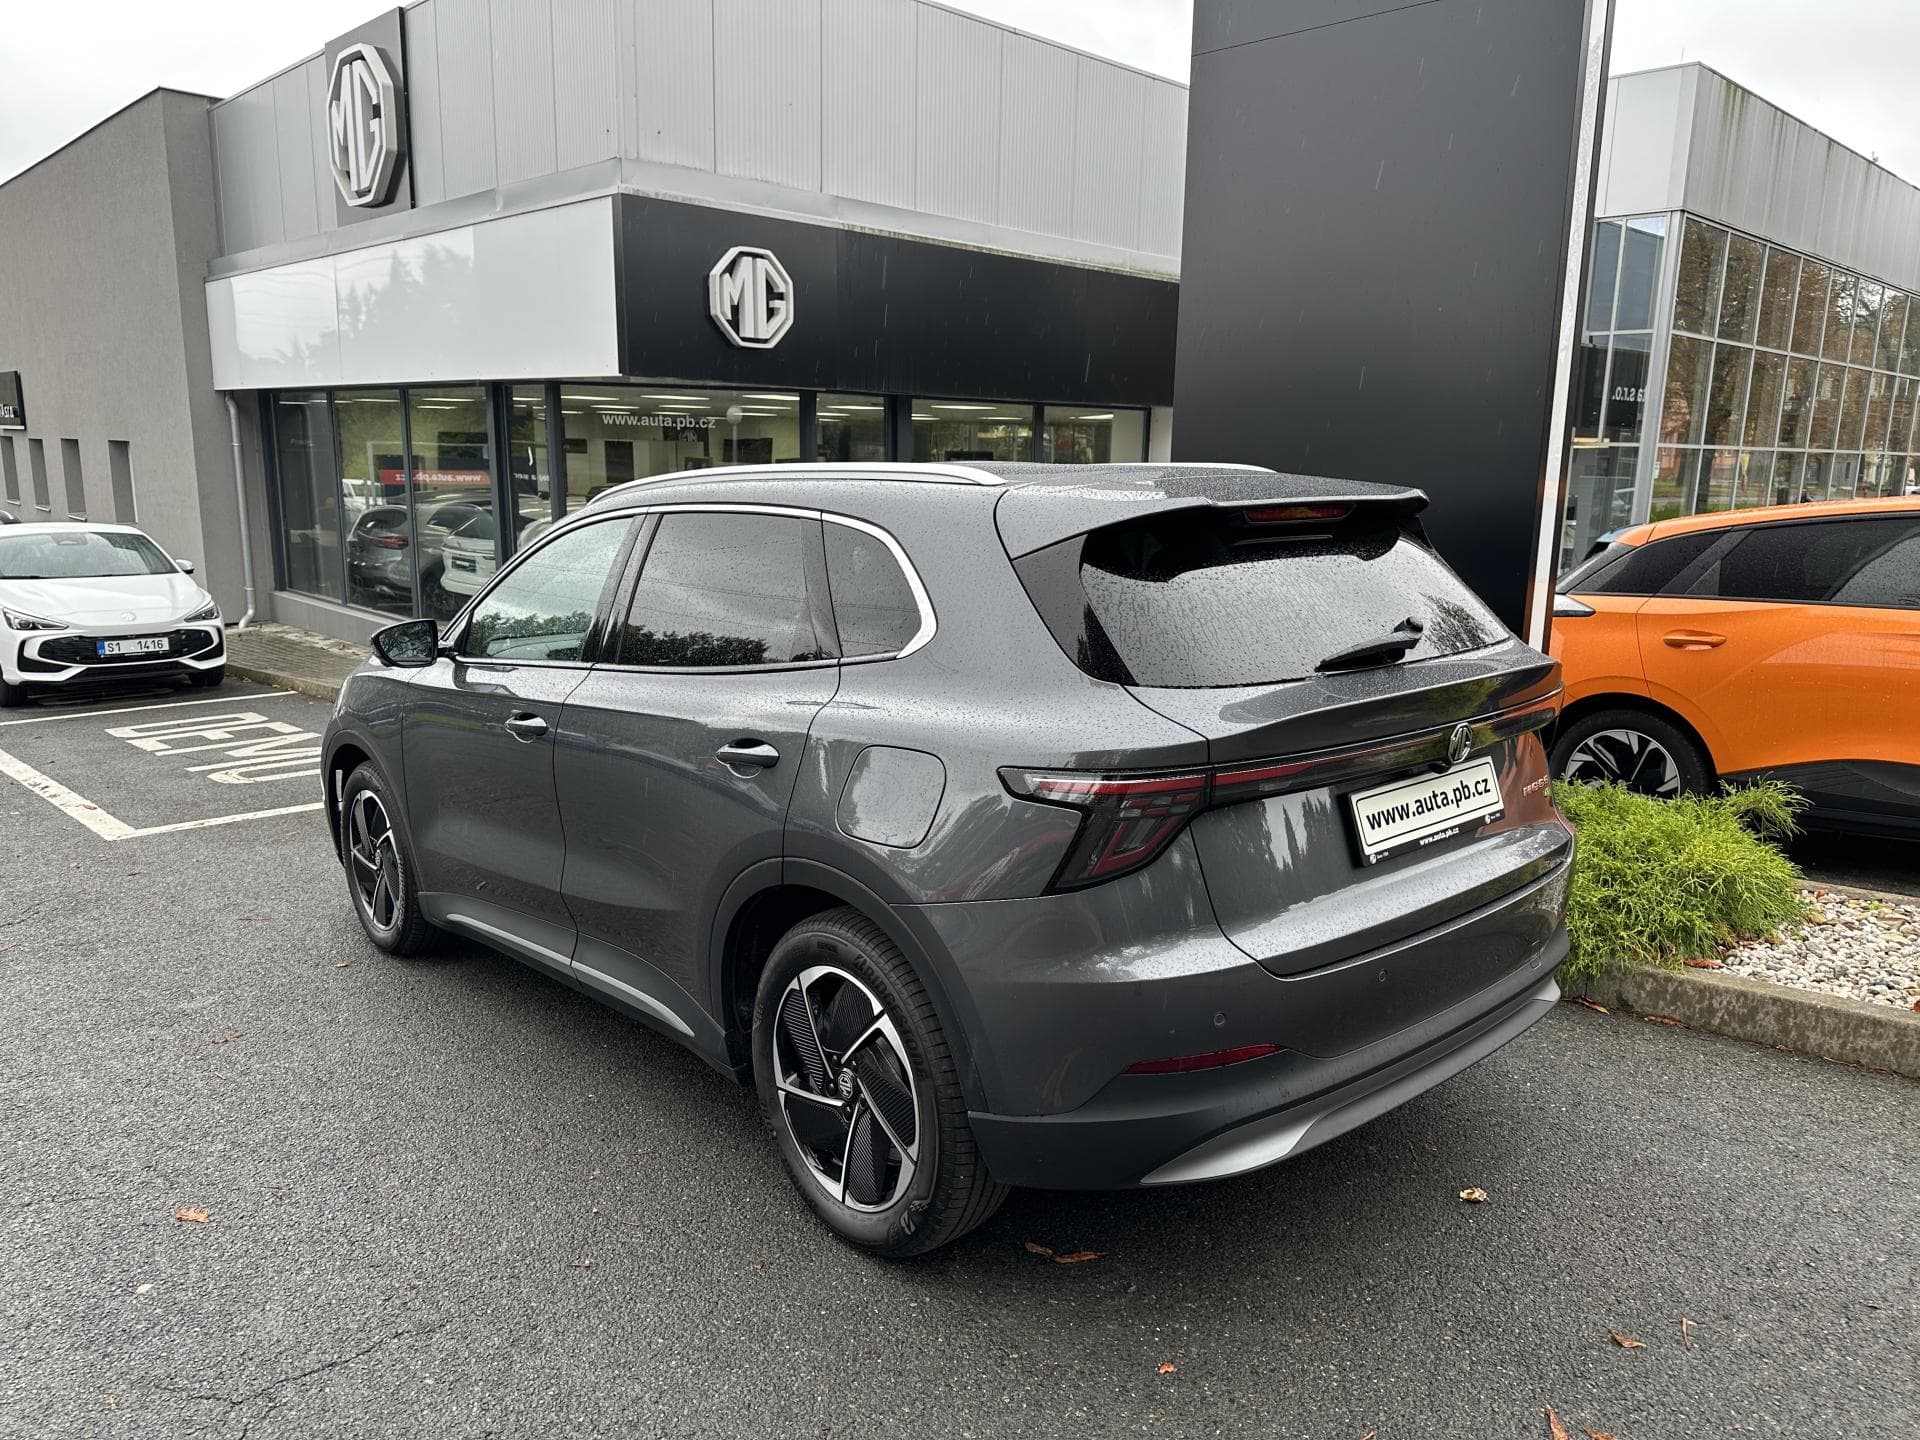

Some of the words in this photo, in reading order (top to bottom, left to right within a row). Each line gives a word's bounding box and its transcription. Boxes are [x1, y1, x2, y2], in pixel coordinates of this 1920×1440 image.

[331, 57, 383, 193] MG
[719, 255, 787, 340] MG
[602, 414, 716, 430] www.auta.pb.cz
[107, 642, 121, 652] S1
[137, 640, 164, 650] 1416
[1366, 778, 1491, 831] www.auta.pb.cz
